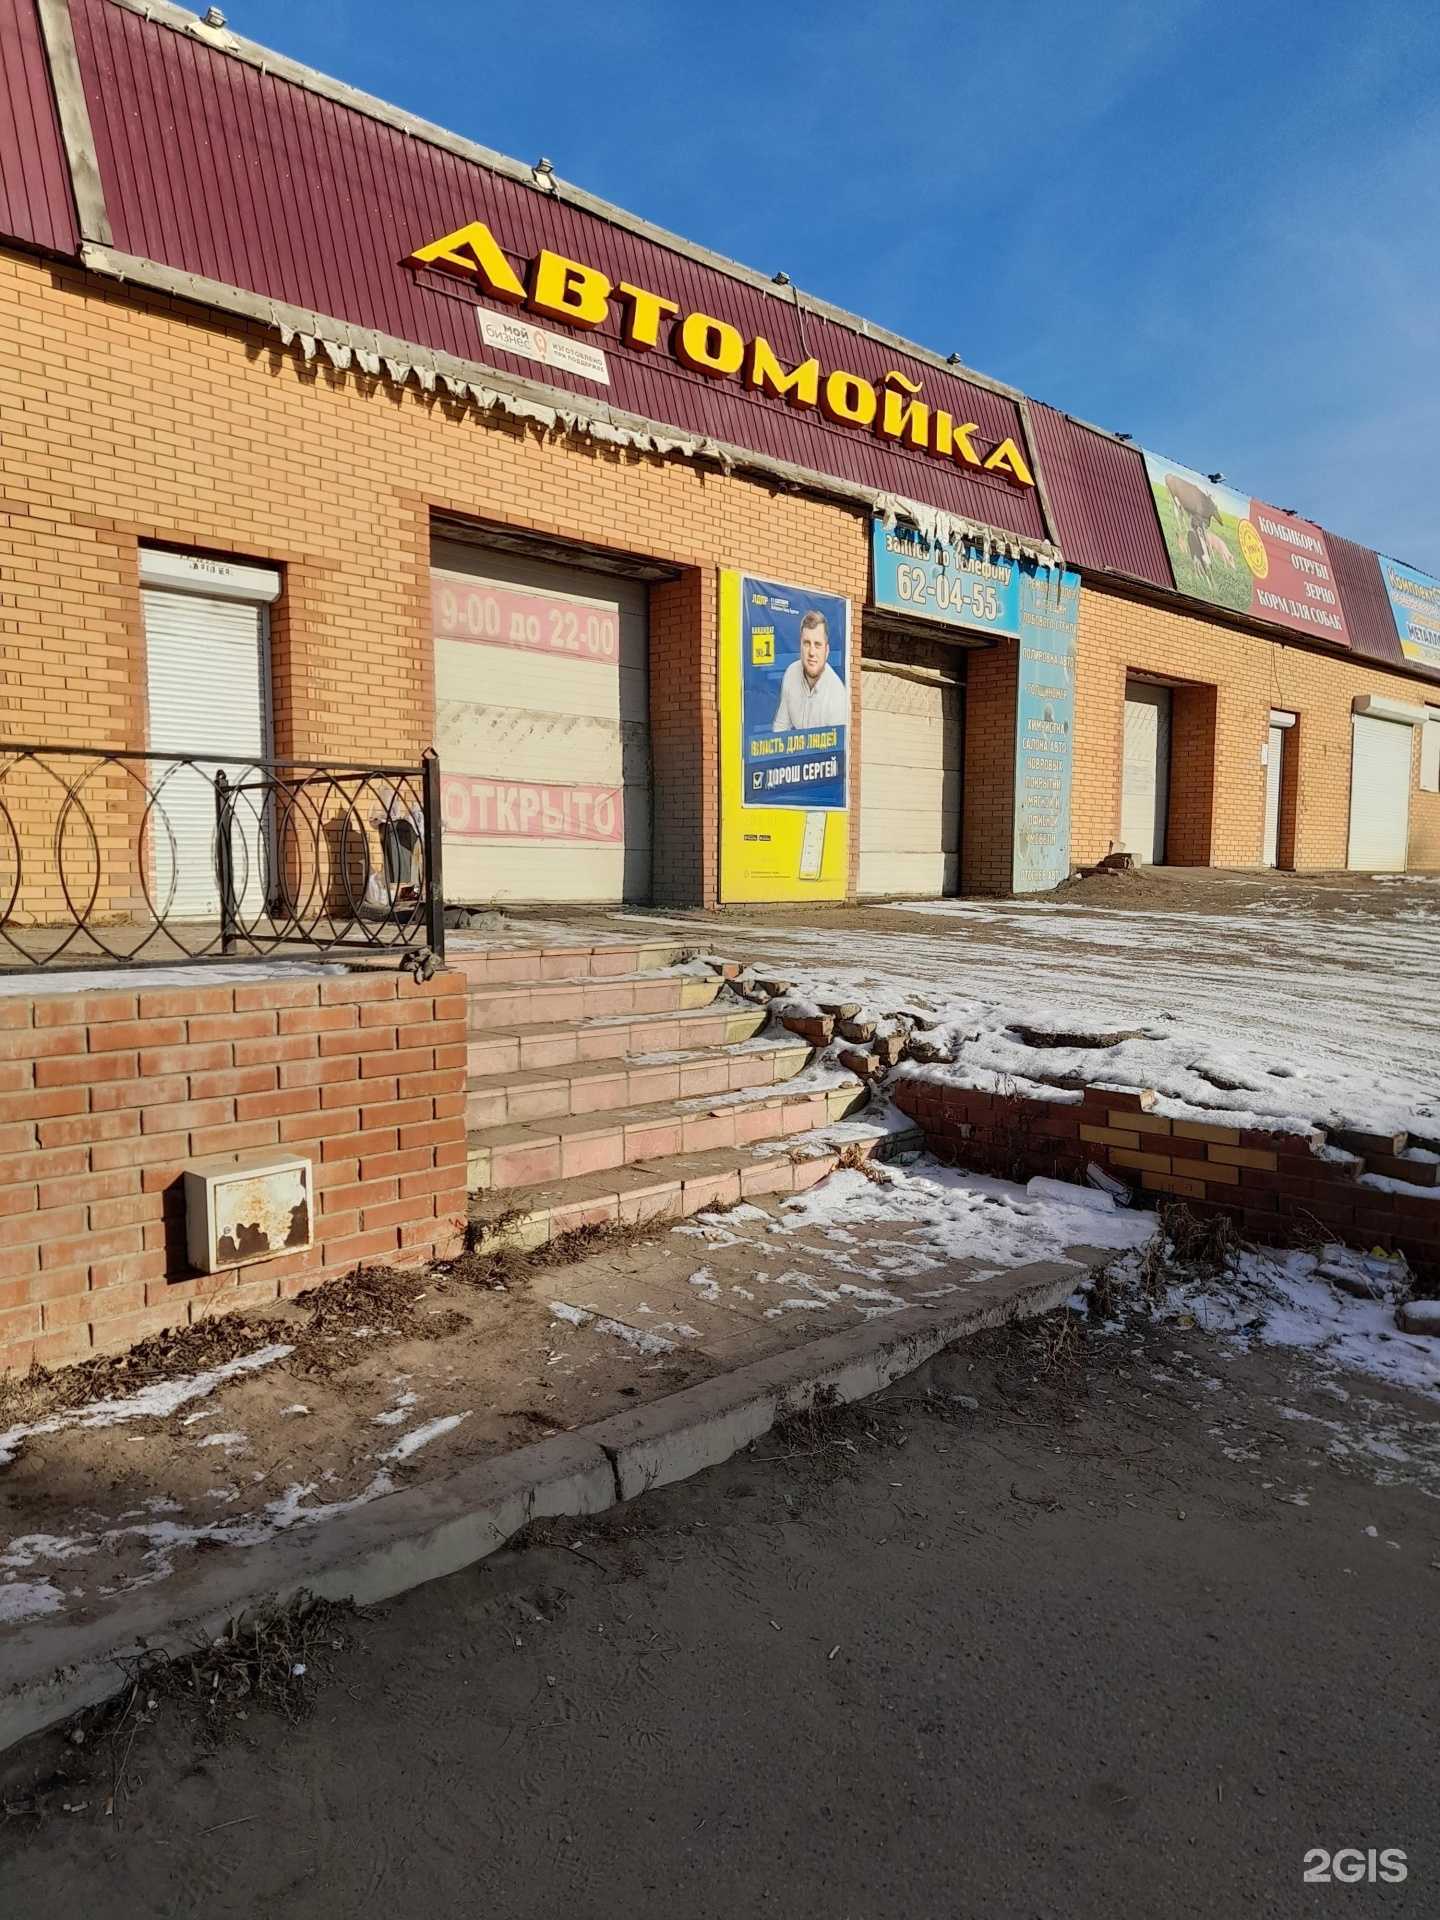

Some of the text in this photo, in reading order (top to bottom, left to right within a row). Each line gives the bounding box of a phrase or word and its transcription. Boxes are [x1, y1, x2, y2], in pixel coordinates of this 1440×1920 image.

[411, 220, 1035, 488] АВТОМОЙКА
[1258, 516, 1324, 555] КОМБИКОРМ
[1291, 553, 1329, 580] ОТРУБИ
[897, 563, 997, 621] 62-04-55
[1256, 588, 1343, 631] КОРМ ДЛЯ СОБАК
[1304, 581, 1336, 605] ЗЕРНО
[441, 587, 615, 656] 9-00 до 22-00
[751, 728, 837, 756] ВЛАСТЬ ДЛЯ ЛЮДЕЙ
[766, 756, 837, 788] ДОРОШ СЕРГЕЙ
[444, 782, 615, 834] ОТКРЫТО
